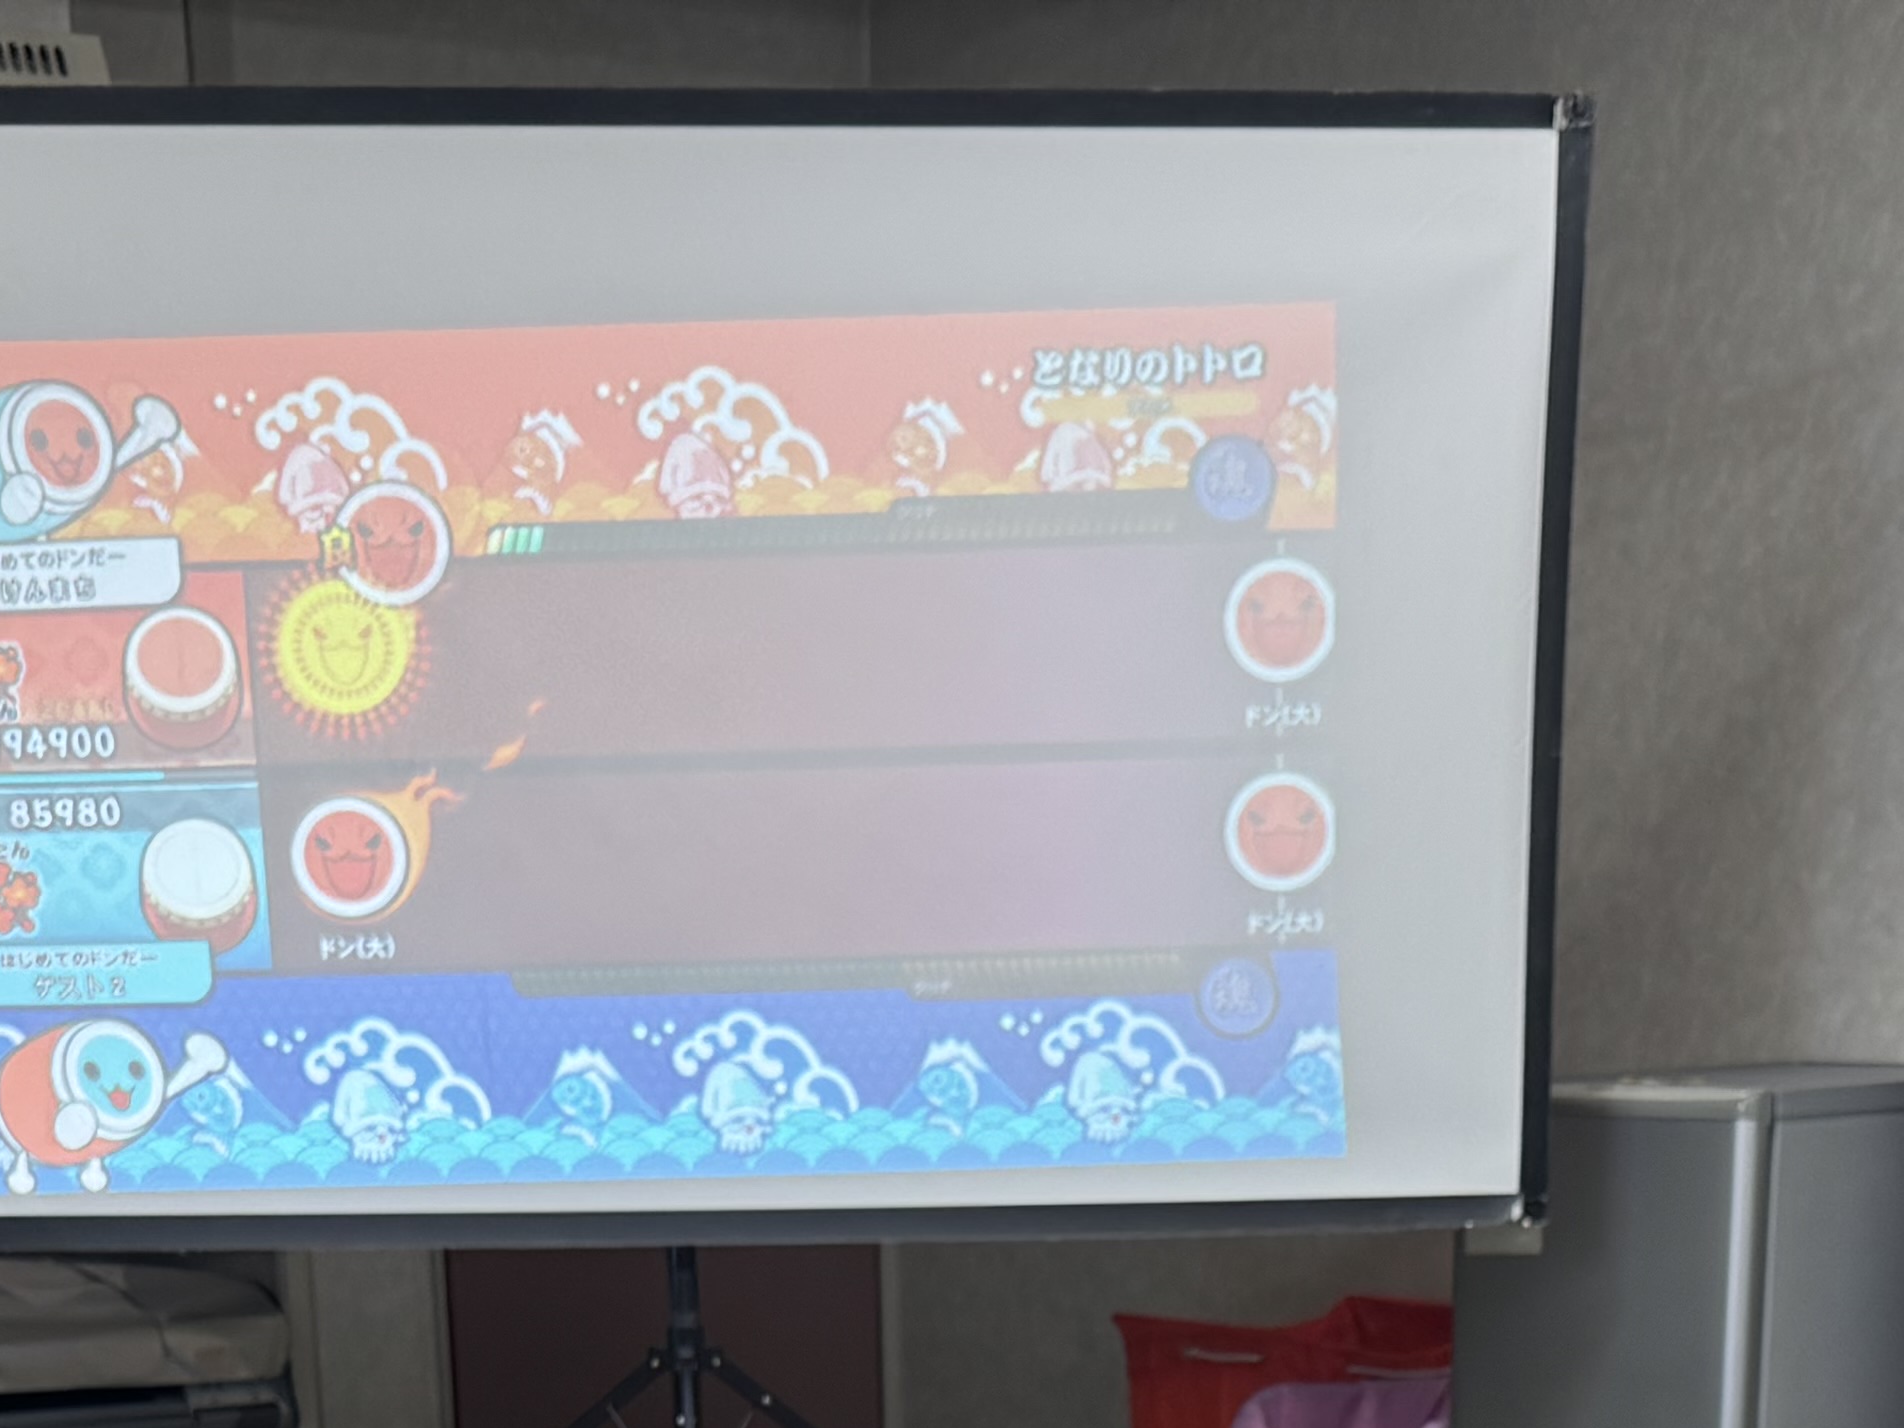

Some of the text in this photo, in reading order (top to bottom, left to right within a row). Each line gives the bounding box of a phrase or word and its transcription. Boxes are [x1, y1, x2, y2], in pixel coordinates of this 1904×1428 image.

[1033, 342, 1265, 388] となりのトトロ
[8, 796, 121, 830] 85980
[0, 947, 159, 970] はじめてのドンだー
[319, 933, 396, 961] ドン(大)
